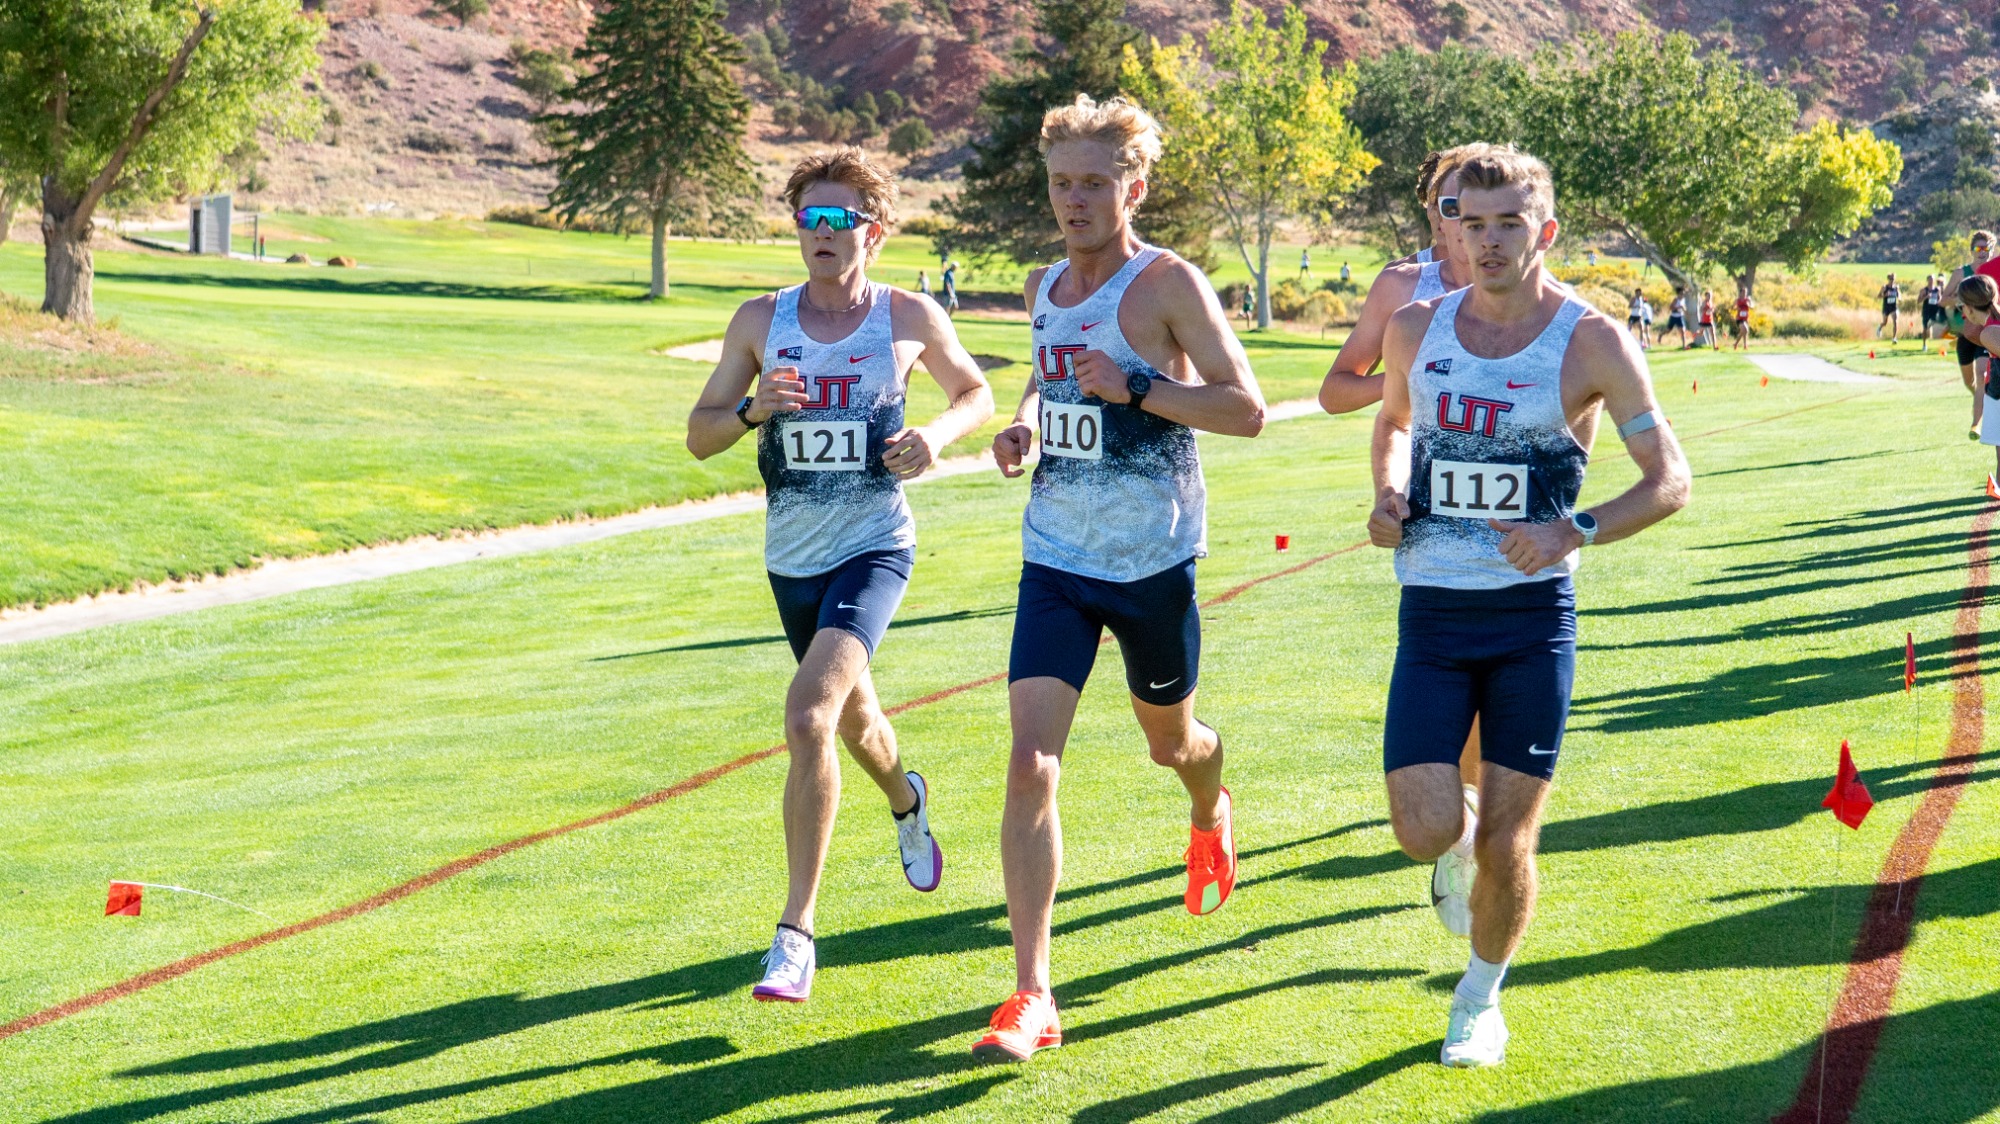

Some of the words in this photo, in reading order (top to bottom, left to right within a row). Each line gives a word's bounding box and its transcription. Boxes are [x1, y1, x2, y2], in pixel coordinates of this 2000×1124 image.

[1435, 360, 1450, 370] SKY
[1044, 410, 1097, 452] 110
[1436, 392, 1514, 438] UT
[790, 429, 861, 464] 121
[1439, 470, 1520, 511] 112
